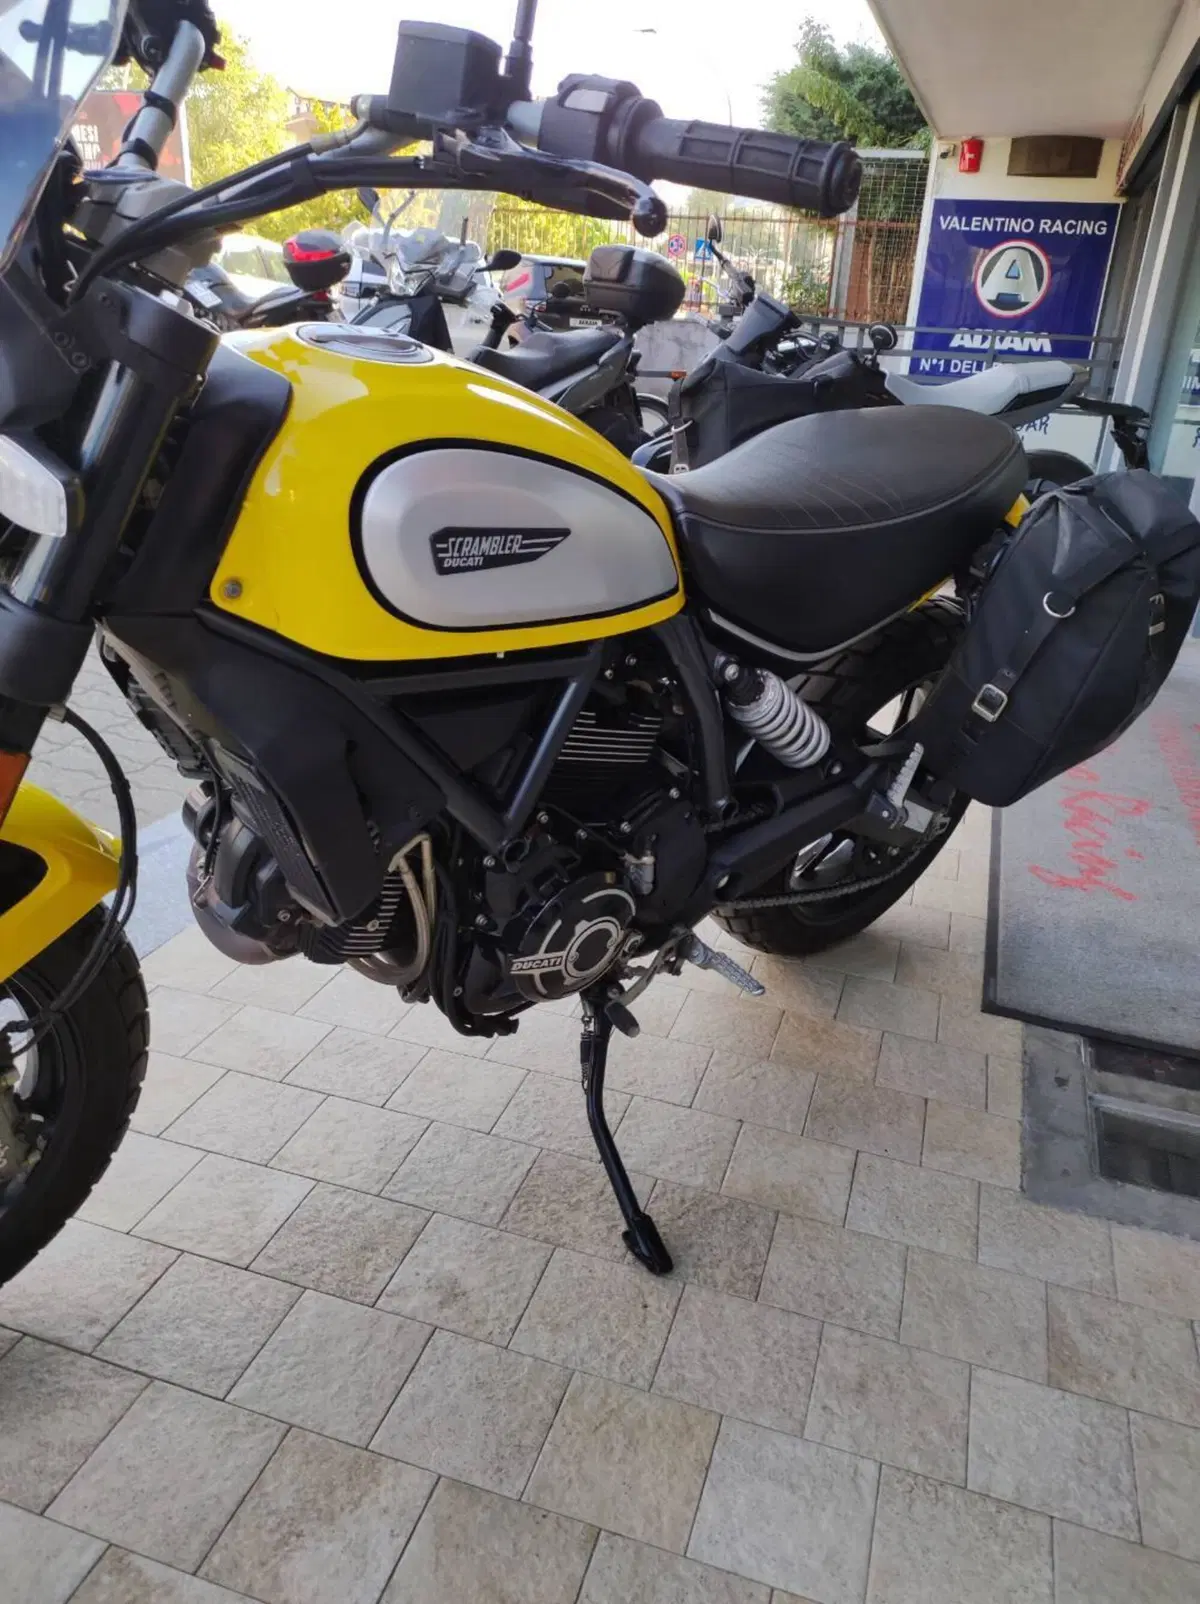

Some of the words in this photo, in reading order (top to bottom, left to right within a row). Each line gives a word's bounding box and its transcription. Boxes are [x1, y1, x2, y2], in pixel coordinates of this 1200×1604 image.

[939, 215, 1035, 234] VALENTINO
[1038, 218, 1108, 236] RACING
[447, 535, 523, 557] SCRAMBLER
[443, 556, 484, 568] DUCATI
[511, 958, 561, 970] DUCATI
